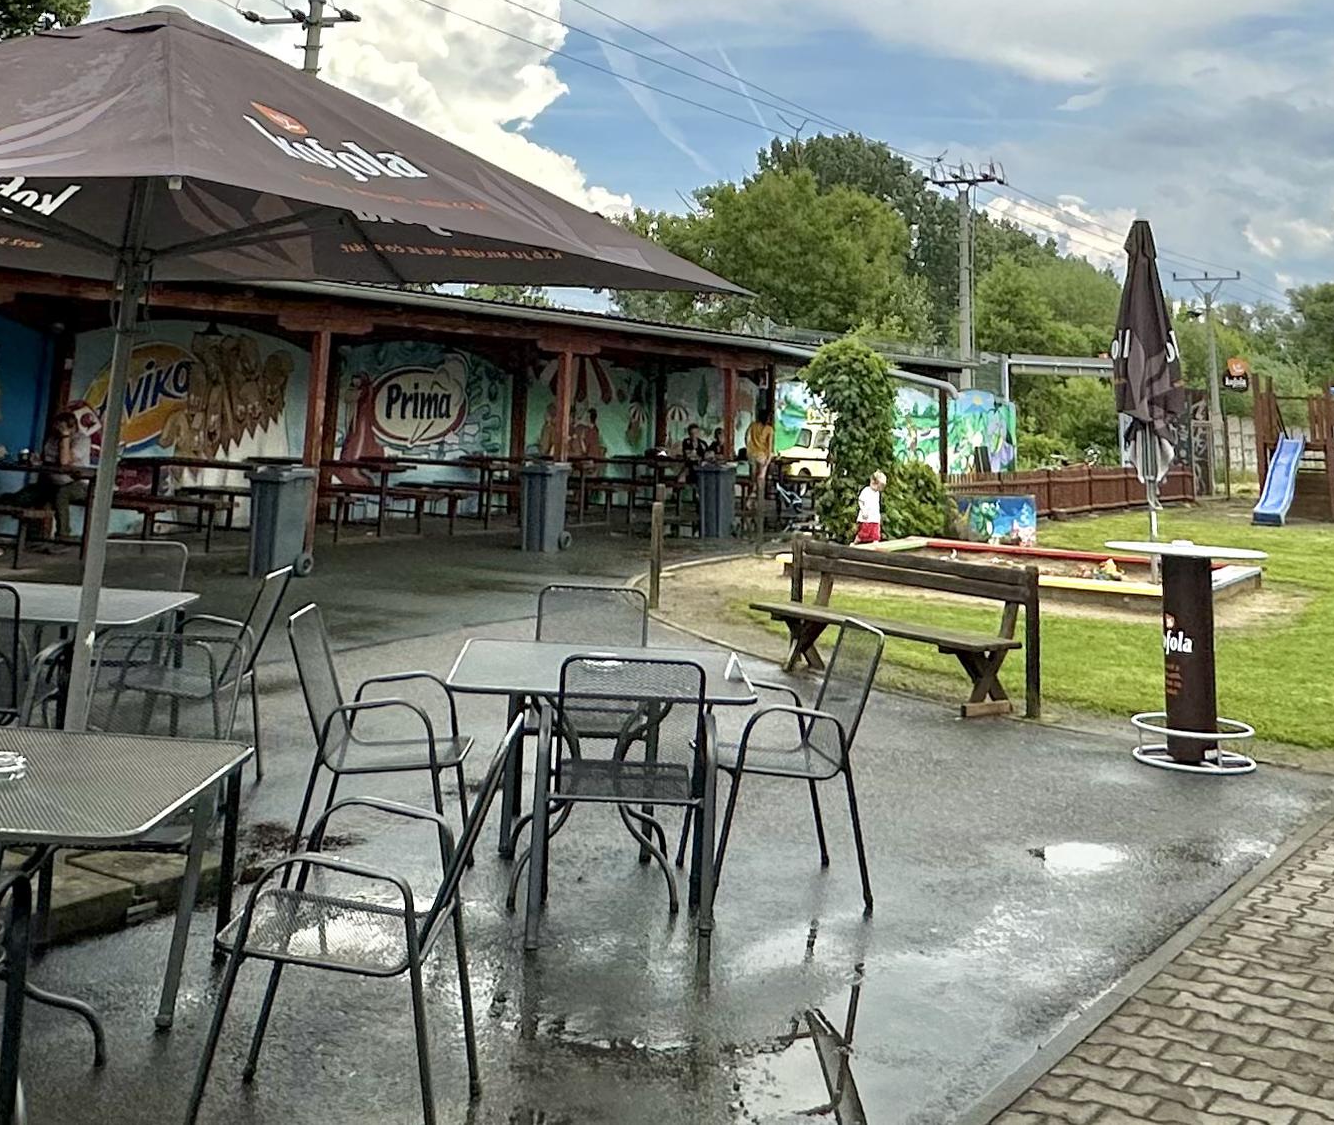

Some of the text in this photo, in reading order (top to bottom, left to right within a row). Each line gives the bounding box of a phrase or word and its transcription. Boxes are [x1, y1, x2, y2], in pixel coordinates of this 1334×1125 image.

[243, 114, 428, 182] kofola
[98, 359, 194, 420] viko
[386, 382, 451, 419] Prima
